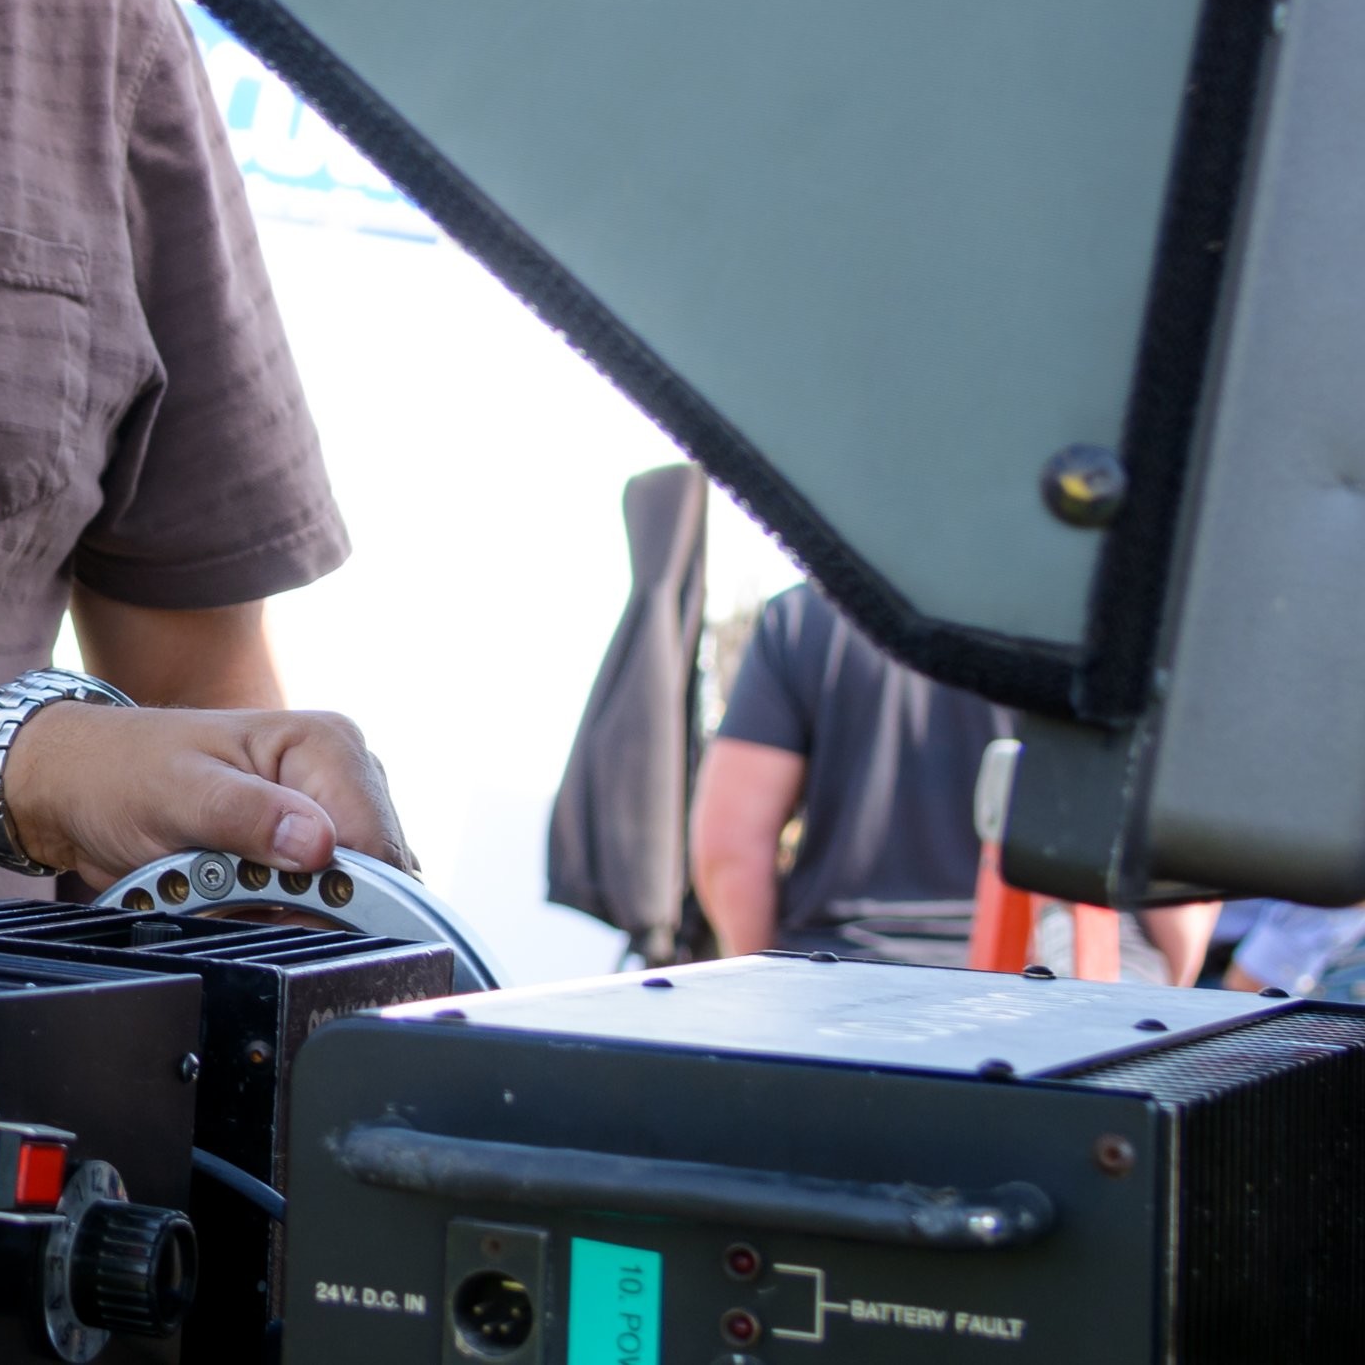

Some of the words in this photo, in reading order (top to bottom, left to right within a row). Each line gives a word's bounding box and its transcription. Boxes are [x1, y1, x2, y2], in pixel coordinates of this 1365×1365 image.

[619, 1264, 645, 1302] 10.
[403, 1292, 428, 1315] IN
[849, 1298, 949, 1331] BATTERY
[954, 1311, 1027, 1340] FAULT
